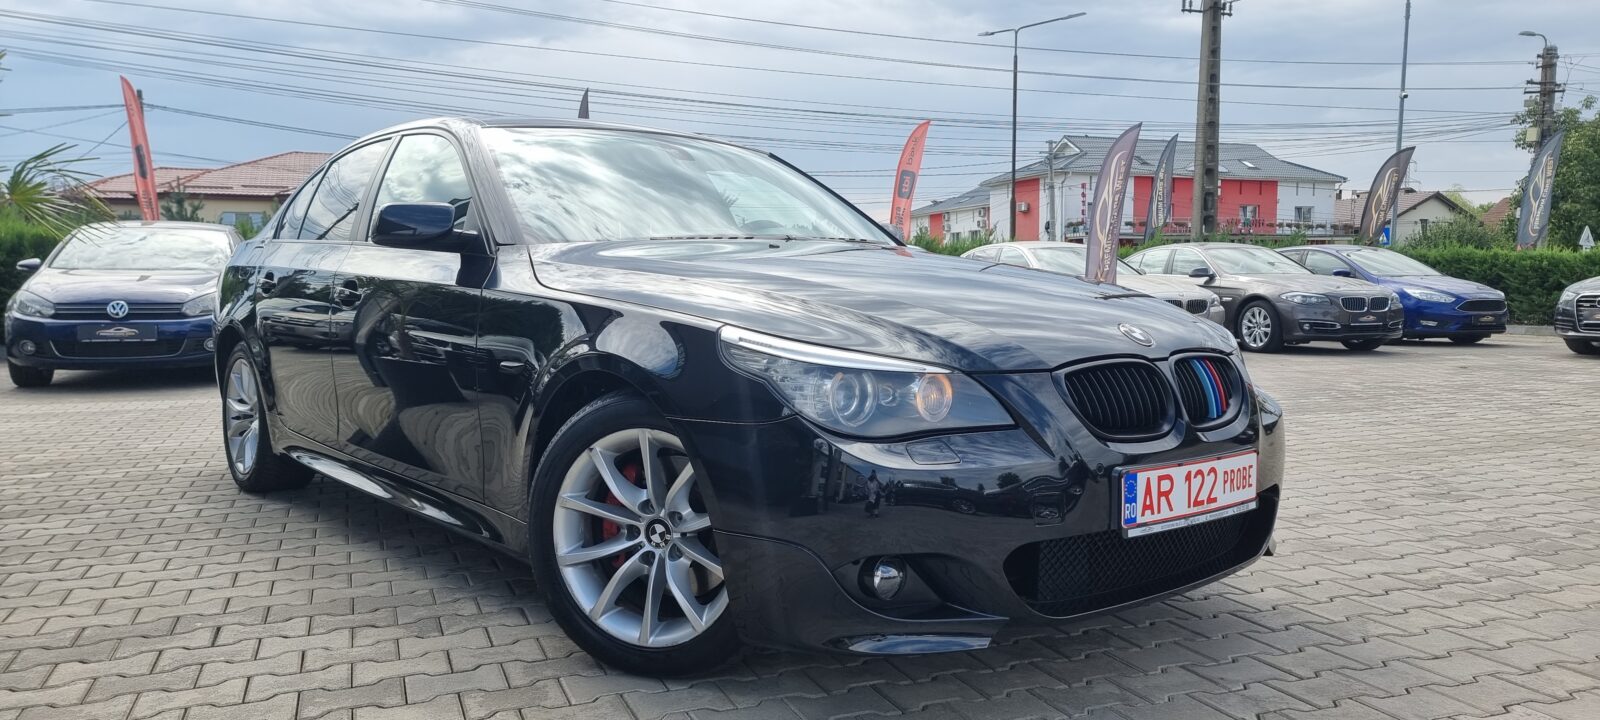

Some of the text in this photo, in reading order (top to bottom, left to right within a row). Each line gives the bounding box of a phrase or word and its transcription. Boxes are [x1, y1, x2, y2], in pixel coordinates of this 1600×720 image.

[1546, 156, 1554, 177] WEST
[902, 176, 911, 192] tbi
[1140, 473, 1175, 517] AR
[1184, 466, 1218, 509] 122
[1223, 464, 1253, 494] PROBE
[1125, 502, 1137, 519] RO
